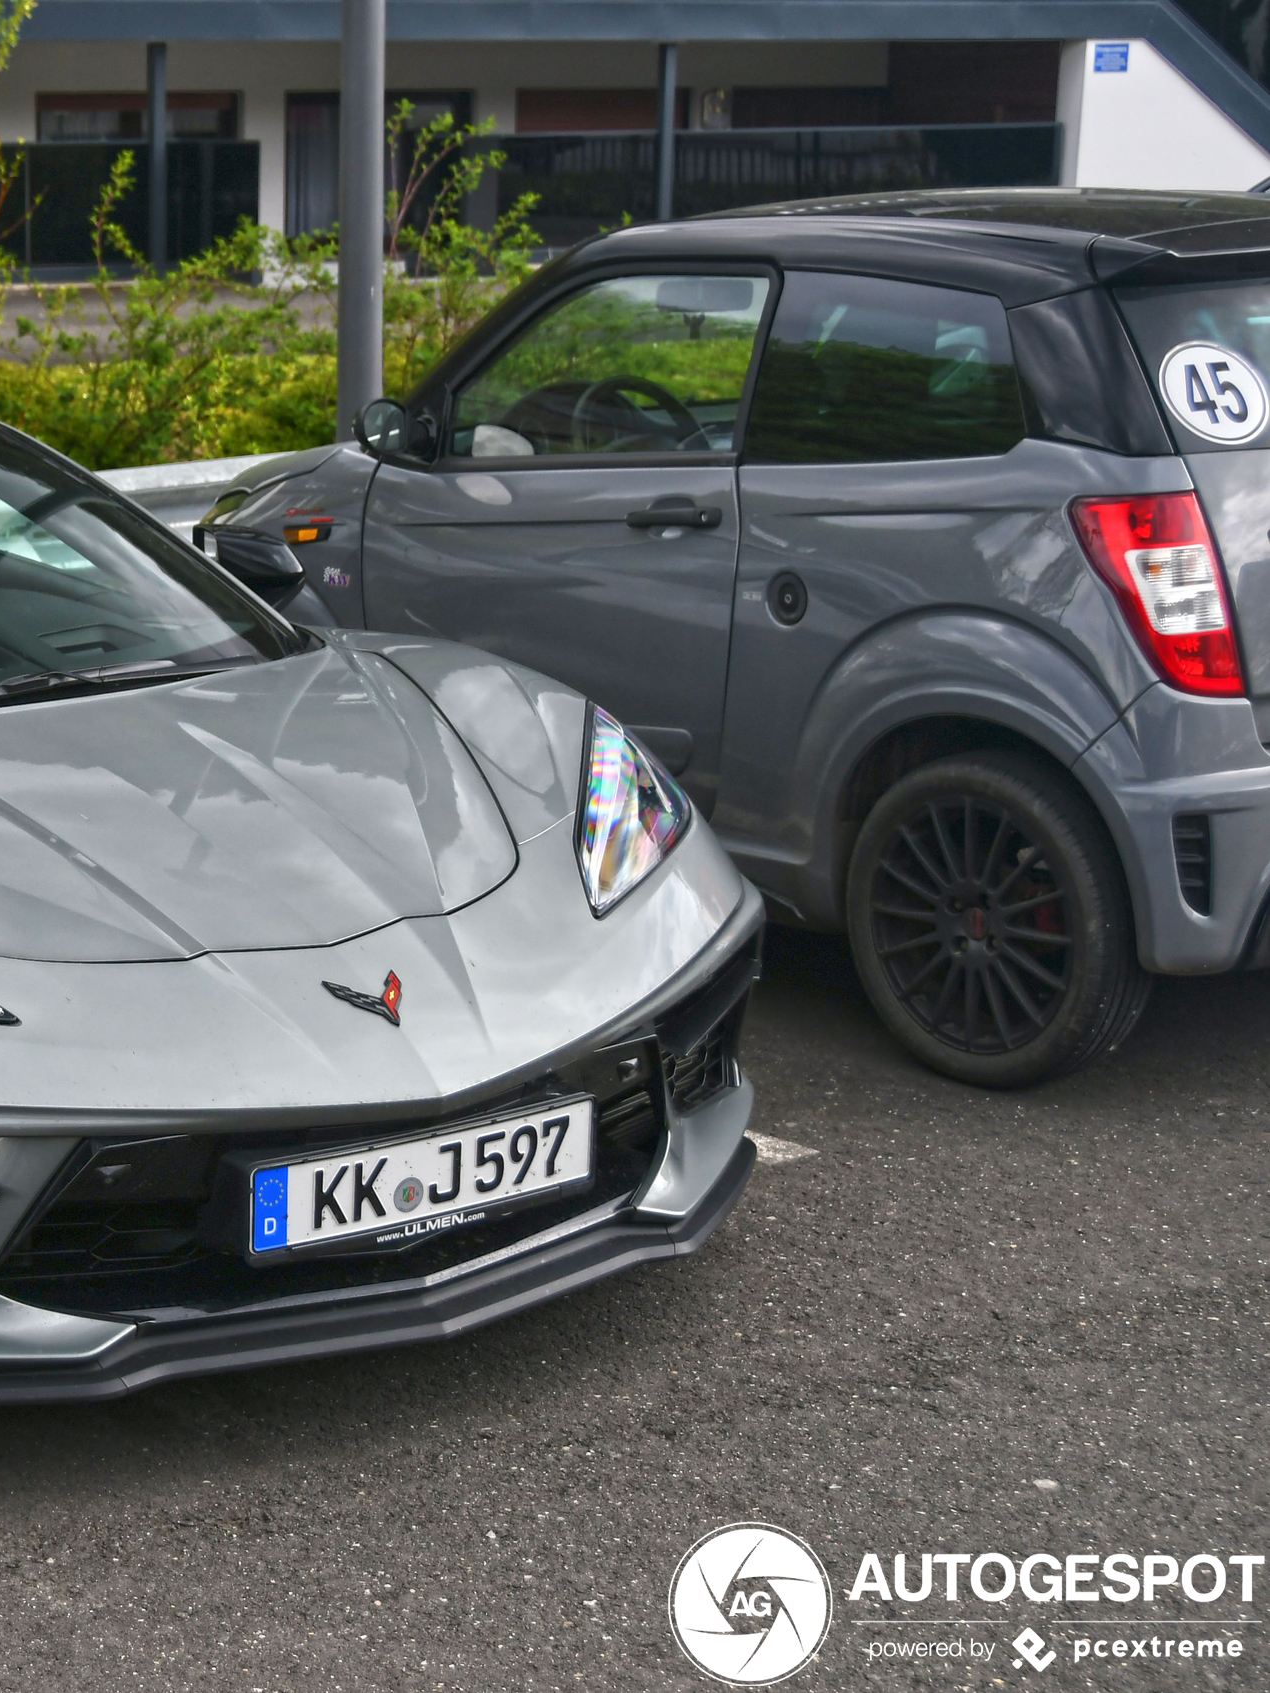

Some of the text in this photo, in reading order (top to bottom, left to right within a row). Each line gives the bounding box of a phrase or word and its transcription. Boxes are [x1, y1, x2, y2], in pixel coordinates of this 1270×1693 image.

[1184, 361, 1249, 424] 45
[312, 1155, 388, 1230] KK
[263, 1217, 278, 1236] D
[376, 1211, 485, 1243] www.ULMEN.com
